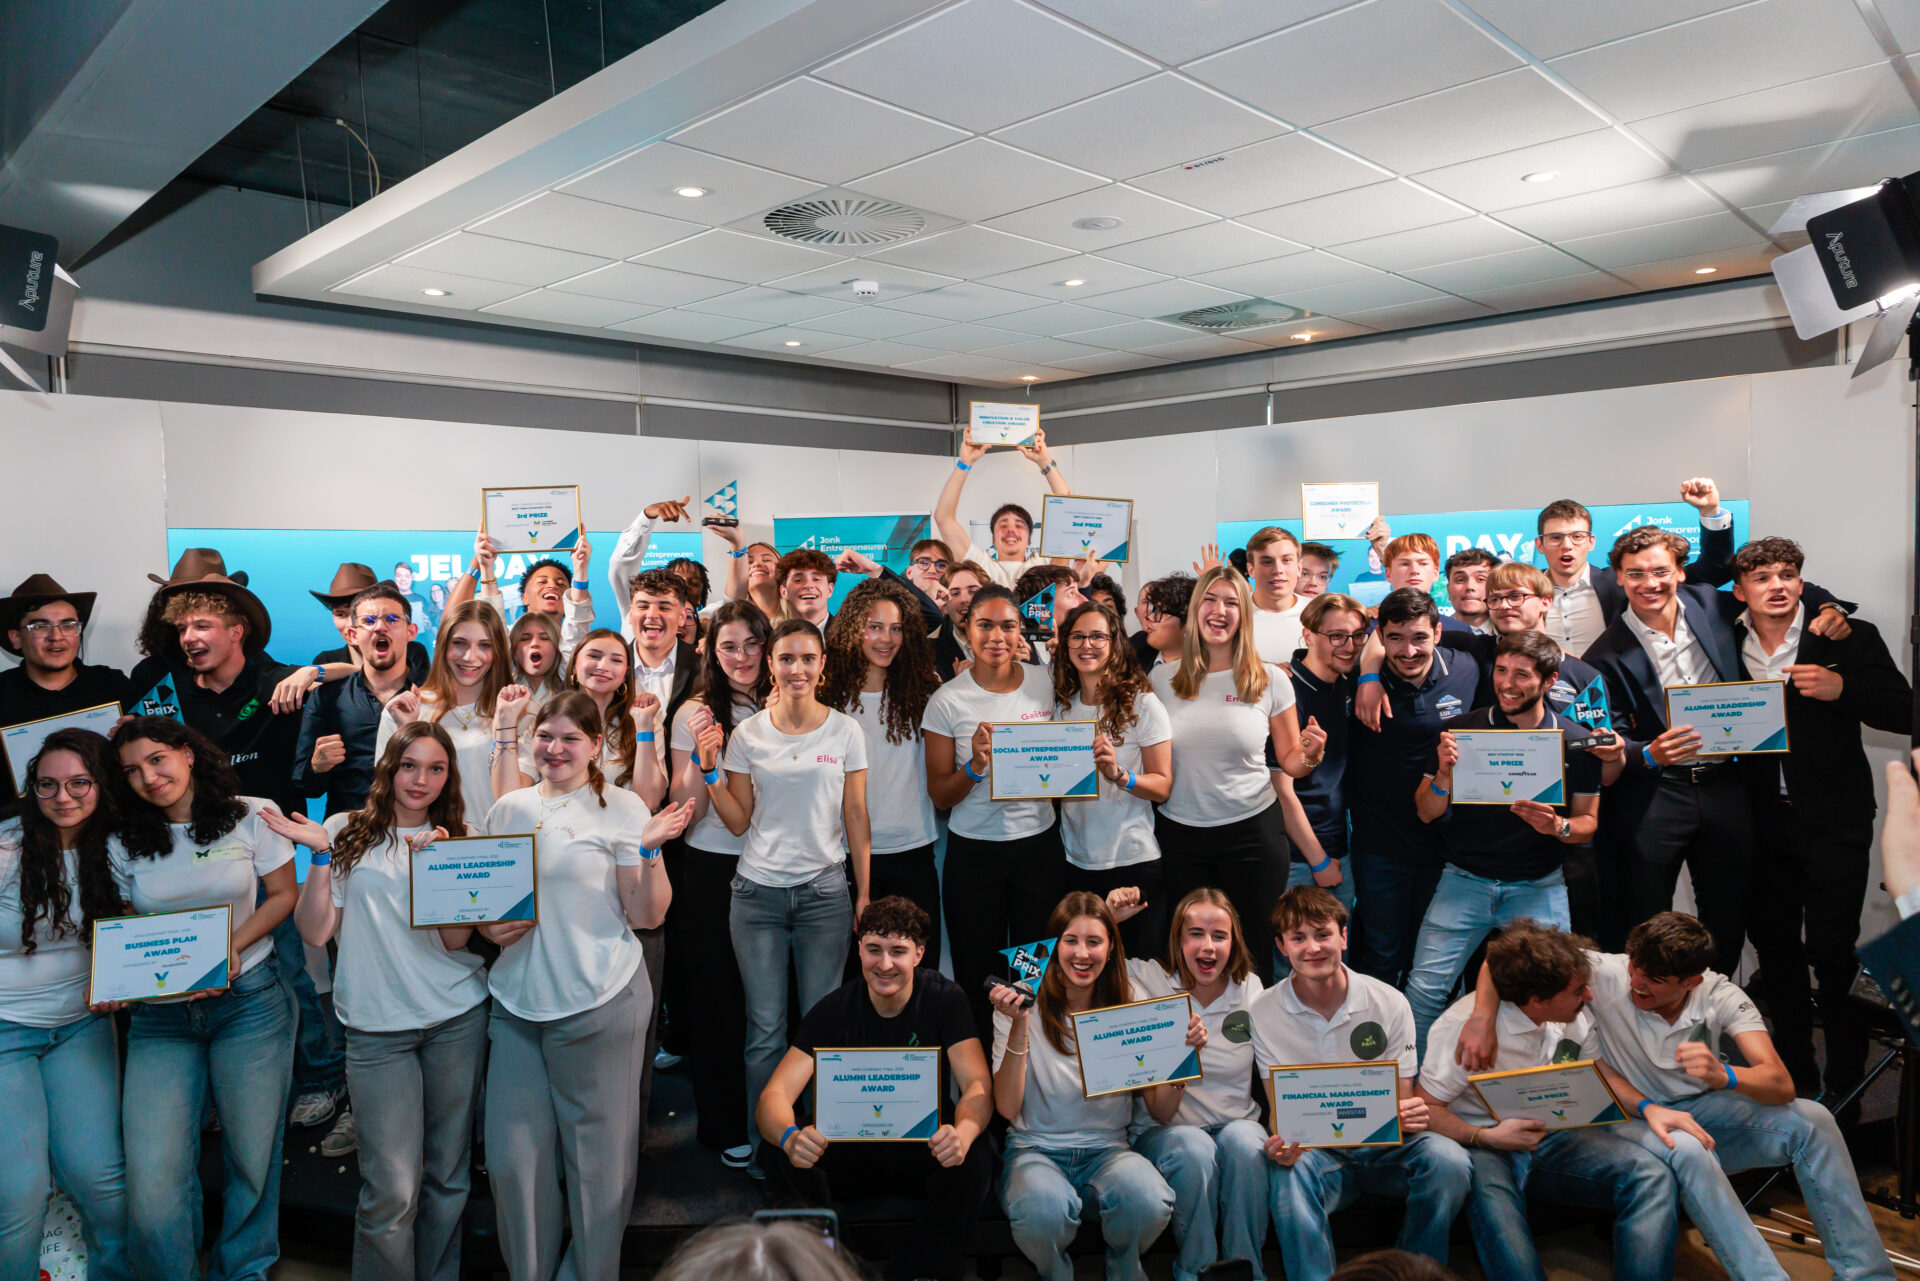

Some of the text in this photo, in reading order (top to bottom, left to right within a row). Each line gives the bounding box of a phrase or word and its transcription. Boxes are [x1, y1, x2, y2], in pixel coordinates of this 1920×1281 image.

[1825, 231, 1858, 289] Aputure
[18, 250, 44, 312] Aputure
[1646, 516, 1672, 525] Jonk
[820, 544, 888, 552] Entrepreneuren
[1446, 534, 1523, 560] DAY
[143, 700, 156, 708] 1er
[1574, 702, 1588, 712] 1er
[1716, 701, 1766, 710] LEADERSHIP
[146, 704, 176, 716] PRIX
[1577, 708, 1606, 720] PRIX
[428, 860, 516, 872] ALUMNI LEADERSHIP
[456, 872, 490, 880] AWARD
[125, 935, 198, 950] BUSINESS PLAN
[144, 948, 181, 958] AWARD
[1014, 958, 1040, 976] PRIX
[1093, 1020, 1175, 1041] ALUMNI LEADERSHIP
[1121, 1035, 1152, 1046] AWARD
[832, 1074, 866, 1082] ALUMNI
[1282, 1090, 1391, 1100] FINANCIAL MANAGEMENT
[40, 1242, 61, 1256] IFE
